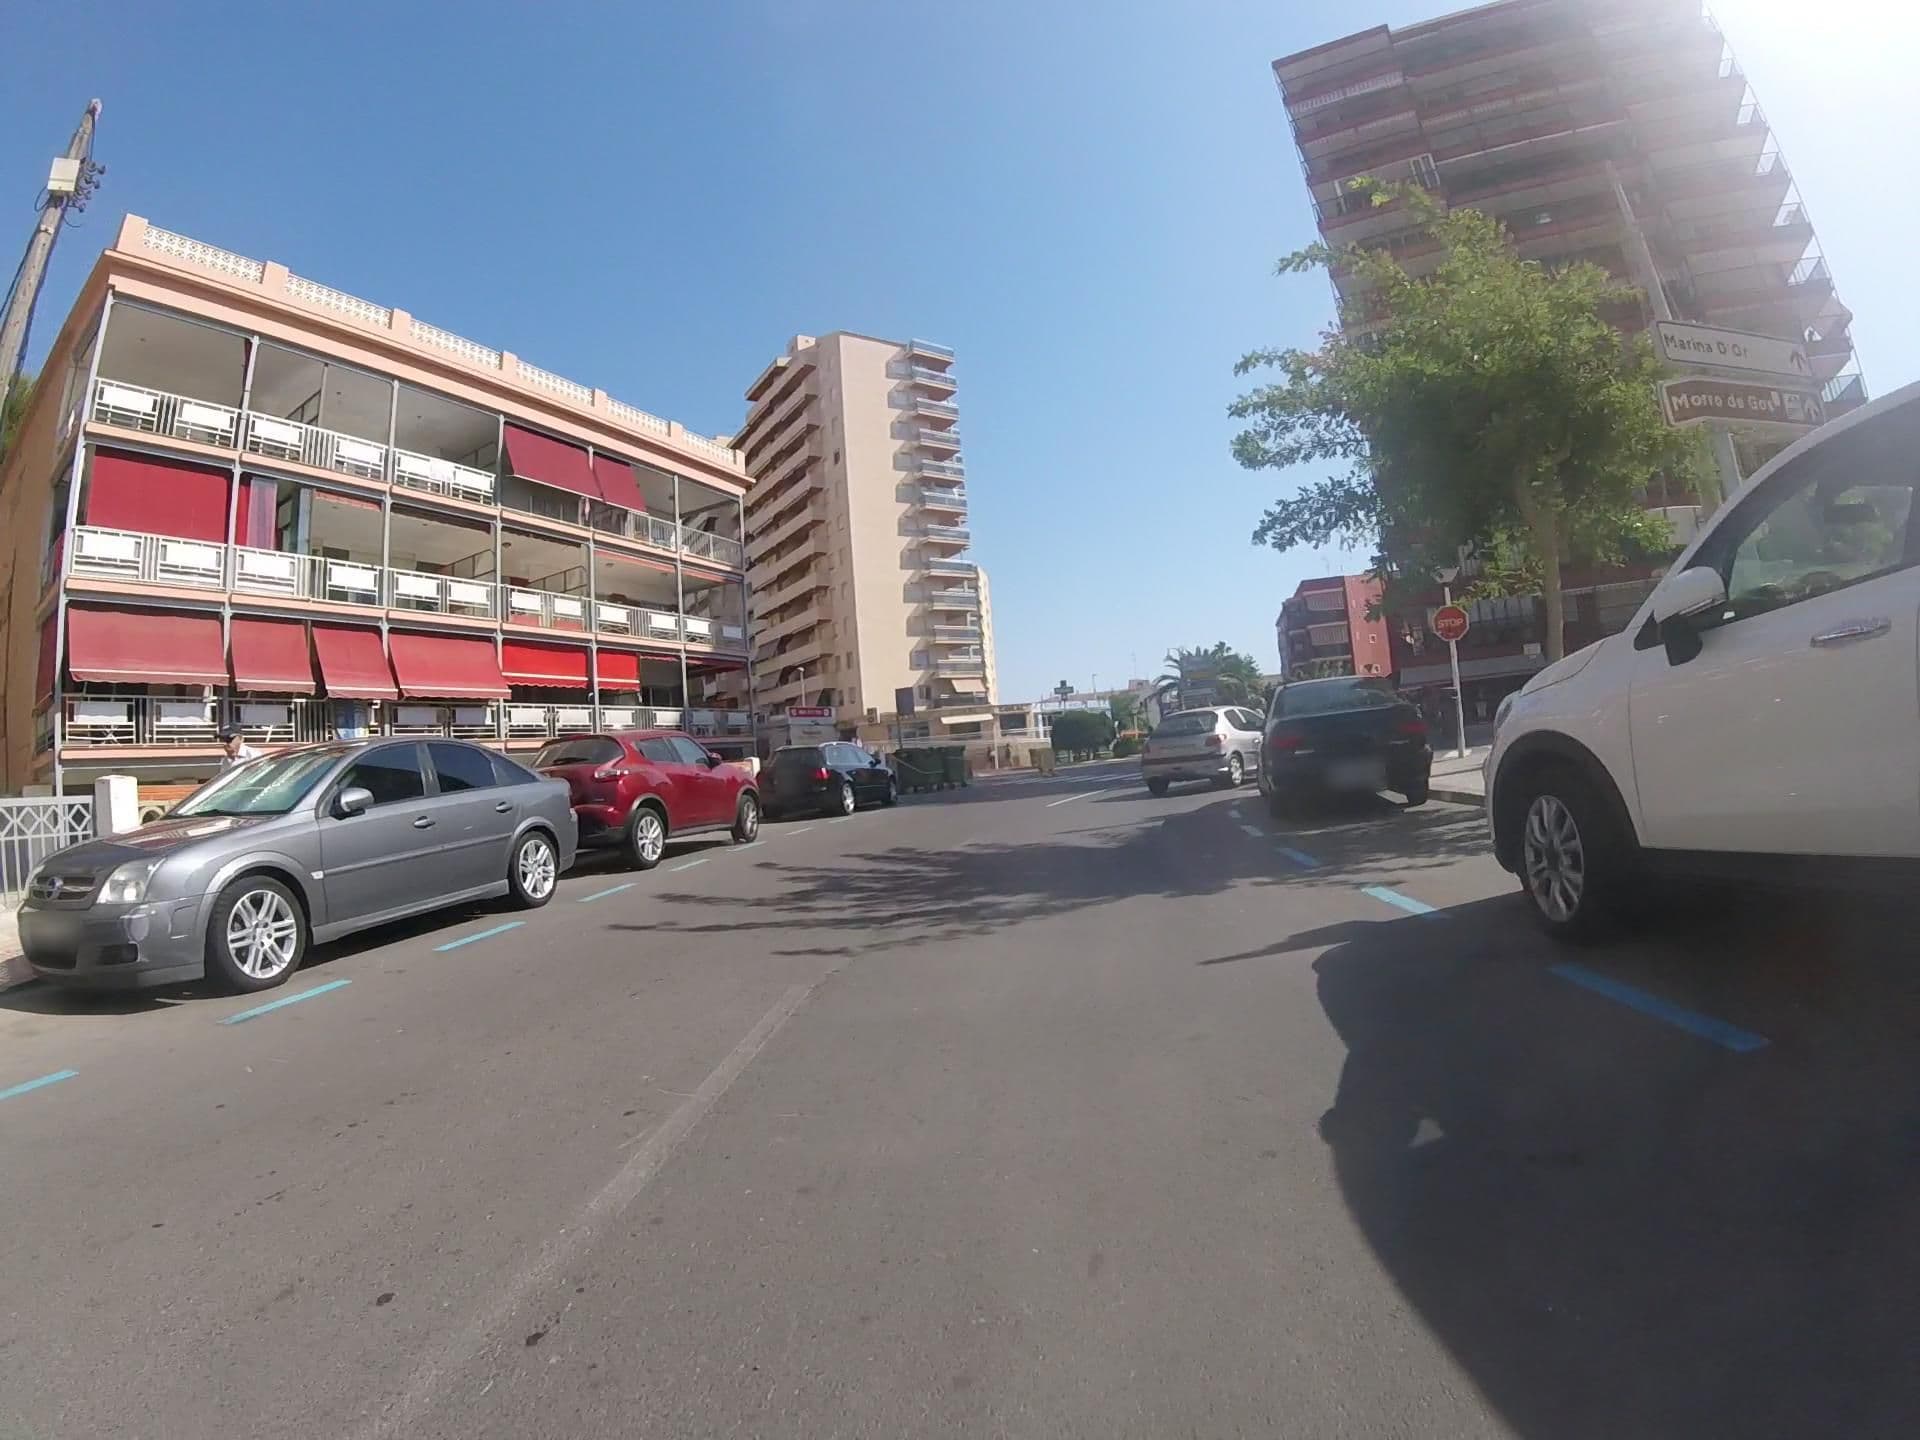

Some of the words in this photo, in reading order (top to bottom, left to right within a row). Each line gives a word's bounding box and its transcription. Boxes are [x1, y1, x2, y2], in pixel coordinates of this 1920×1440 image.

[1663, 333, 1713, 353] Marina
[1672, 392, 1722, 411] Morro
[1728, 395, 1744, 409] de
[1437, 617, 1465, 628] STOP
